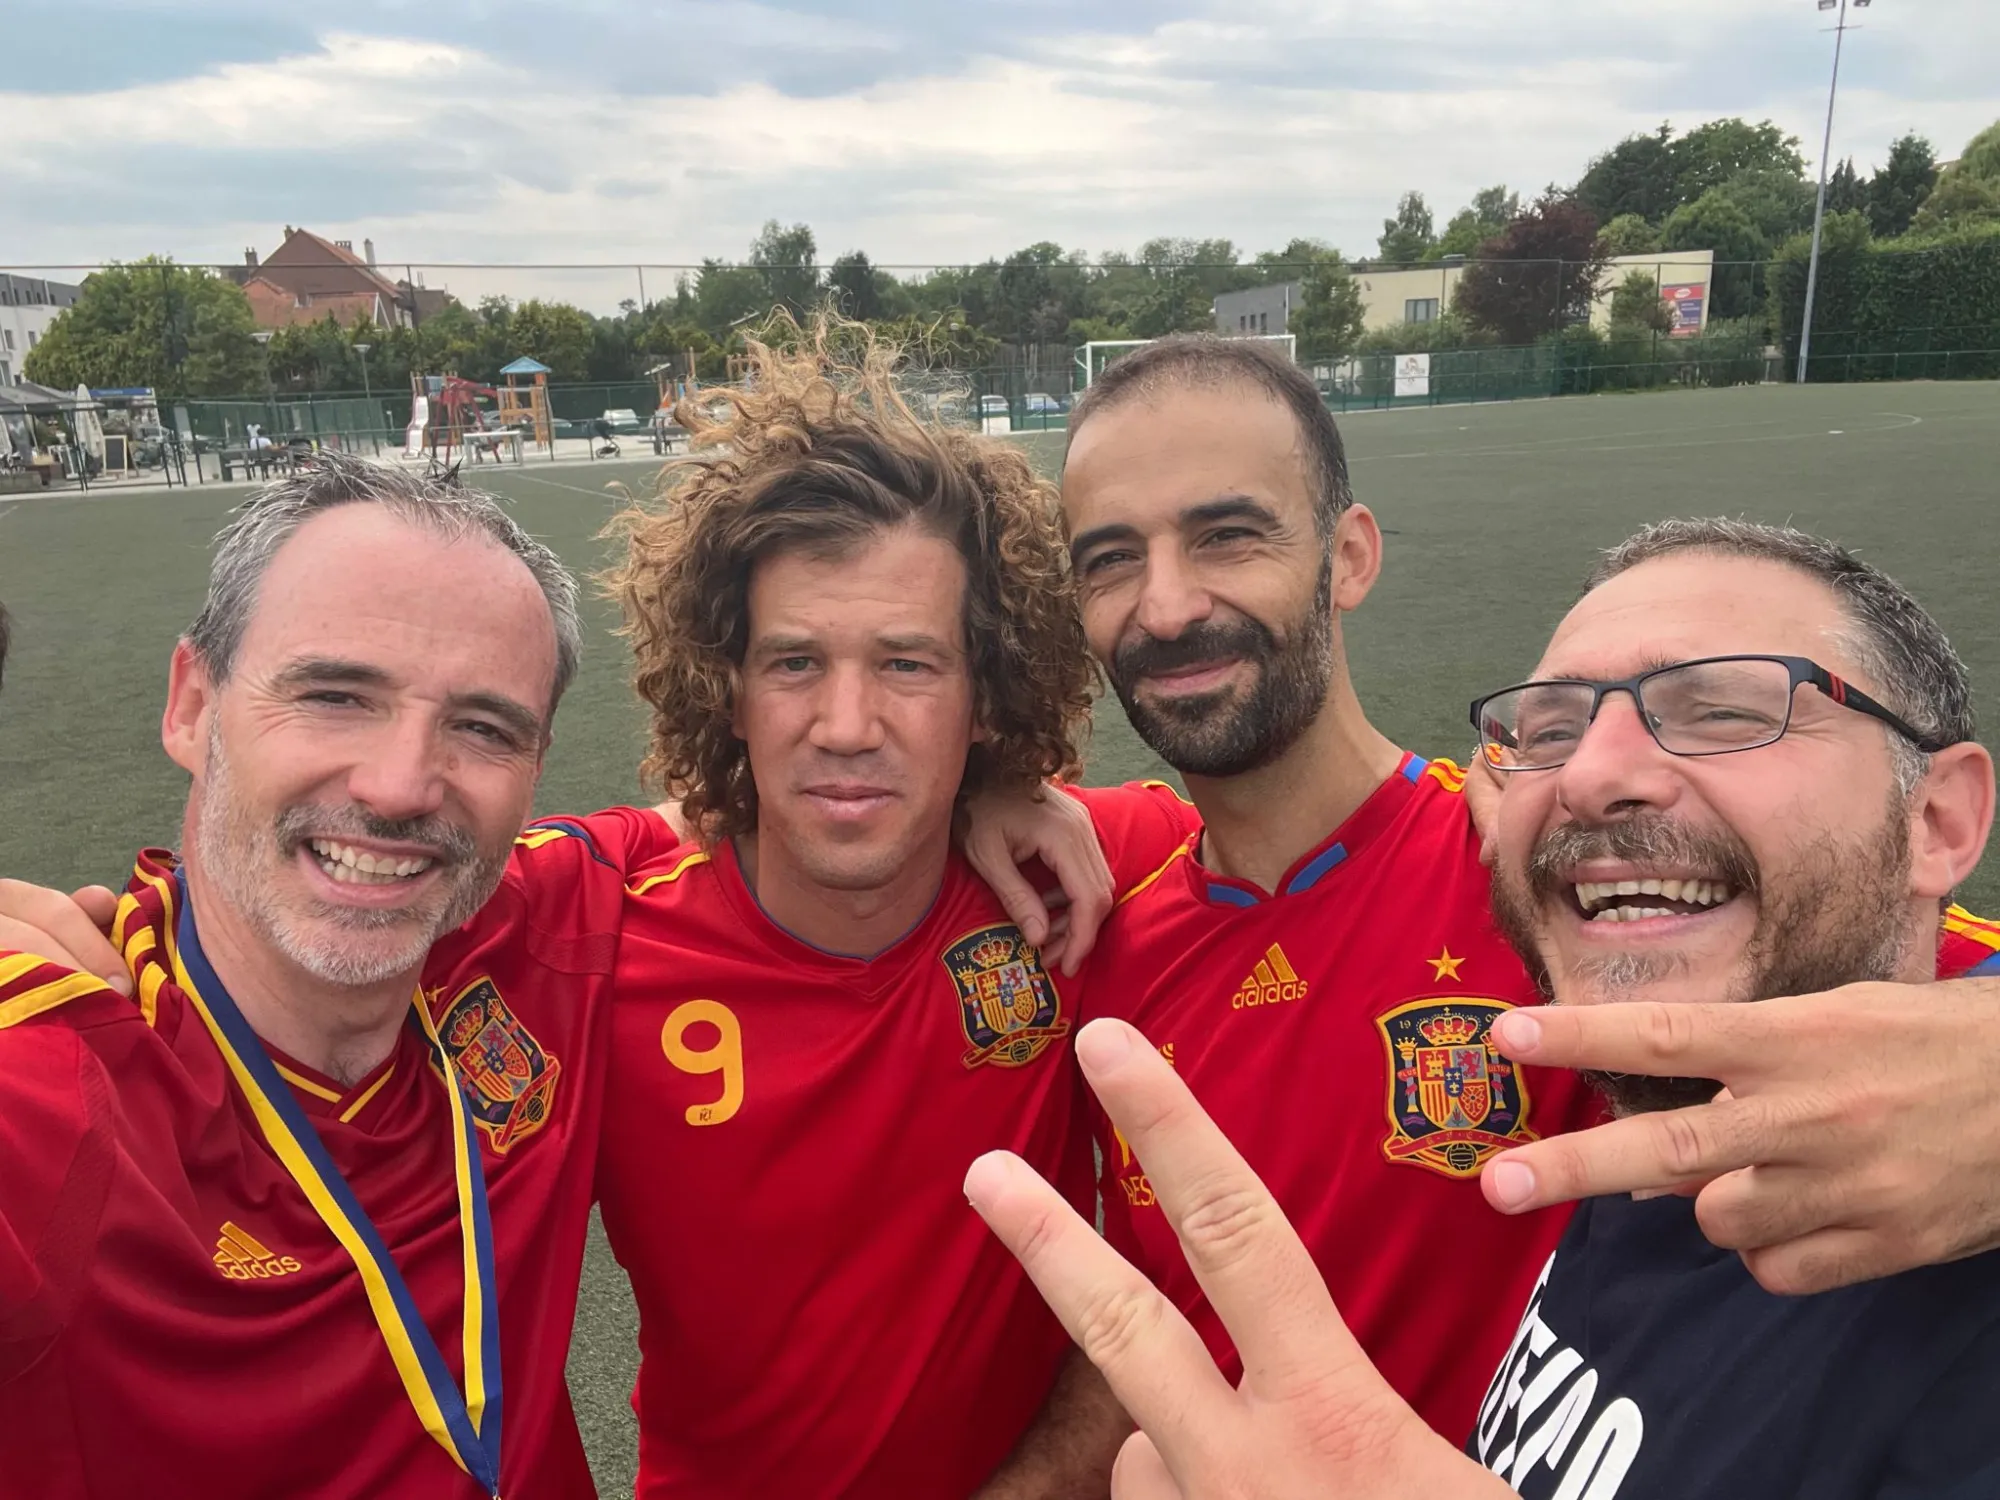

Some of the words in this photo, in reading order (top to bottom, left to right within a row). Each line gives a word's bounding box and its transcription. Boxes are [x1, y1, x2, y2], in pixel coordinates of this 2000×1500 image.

[1232, 980, 1309, 1009] adidas
[1399, 1019, 1412, 1030] 19
[660, 999, 744, 1126] 9
[215, 1255, 302, 1280] adidas
